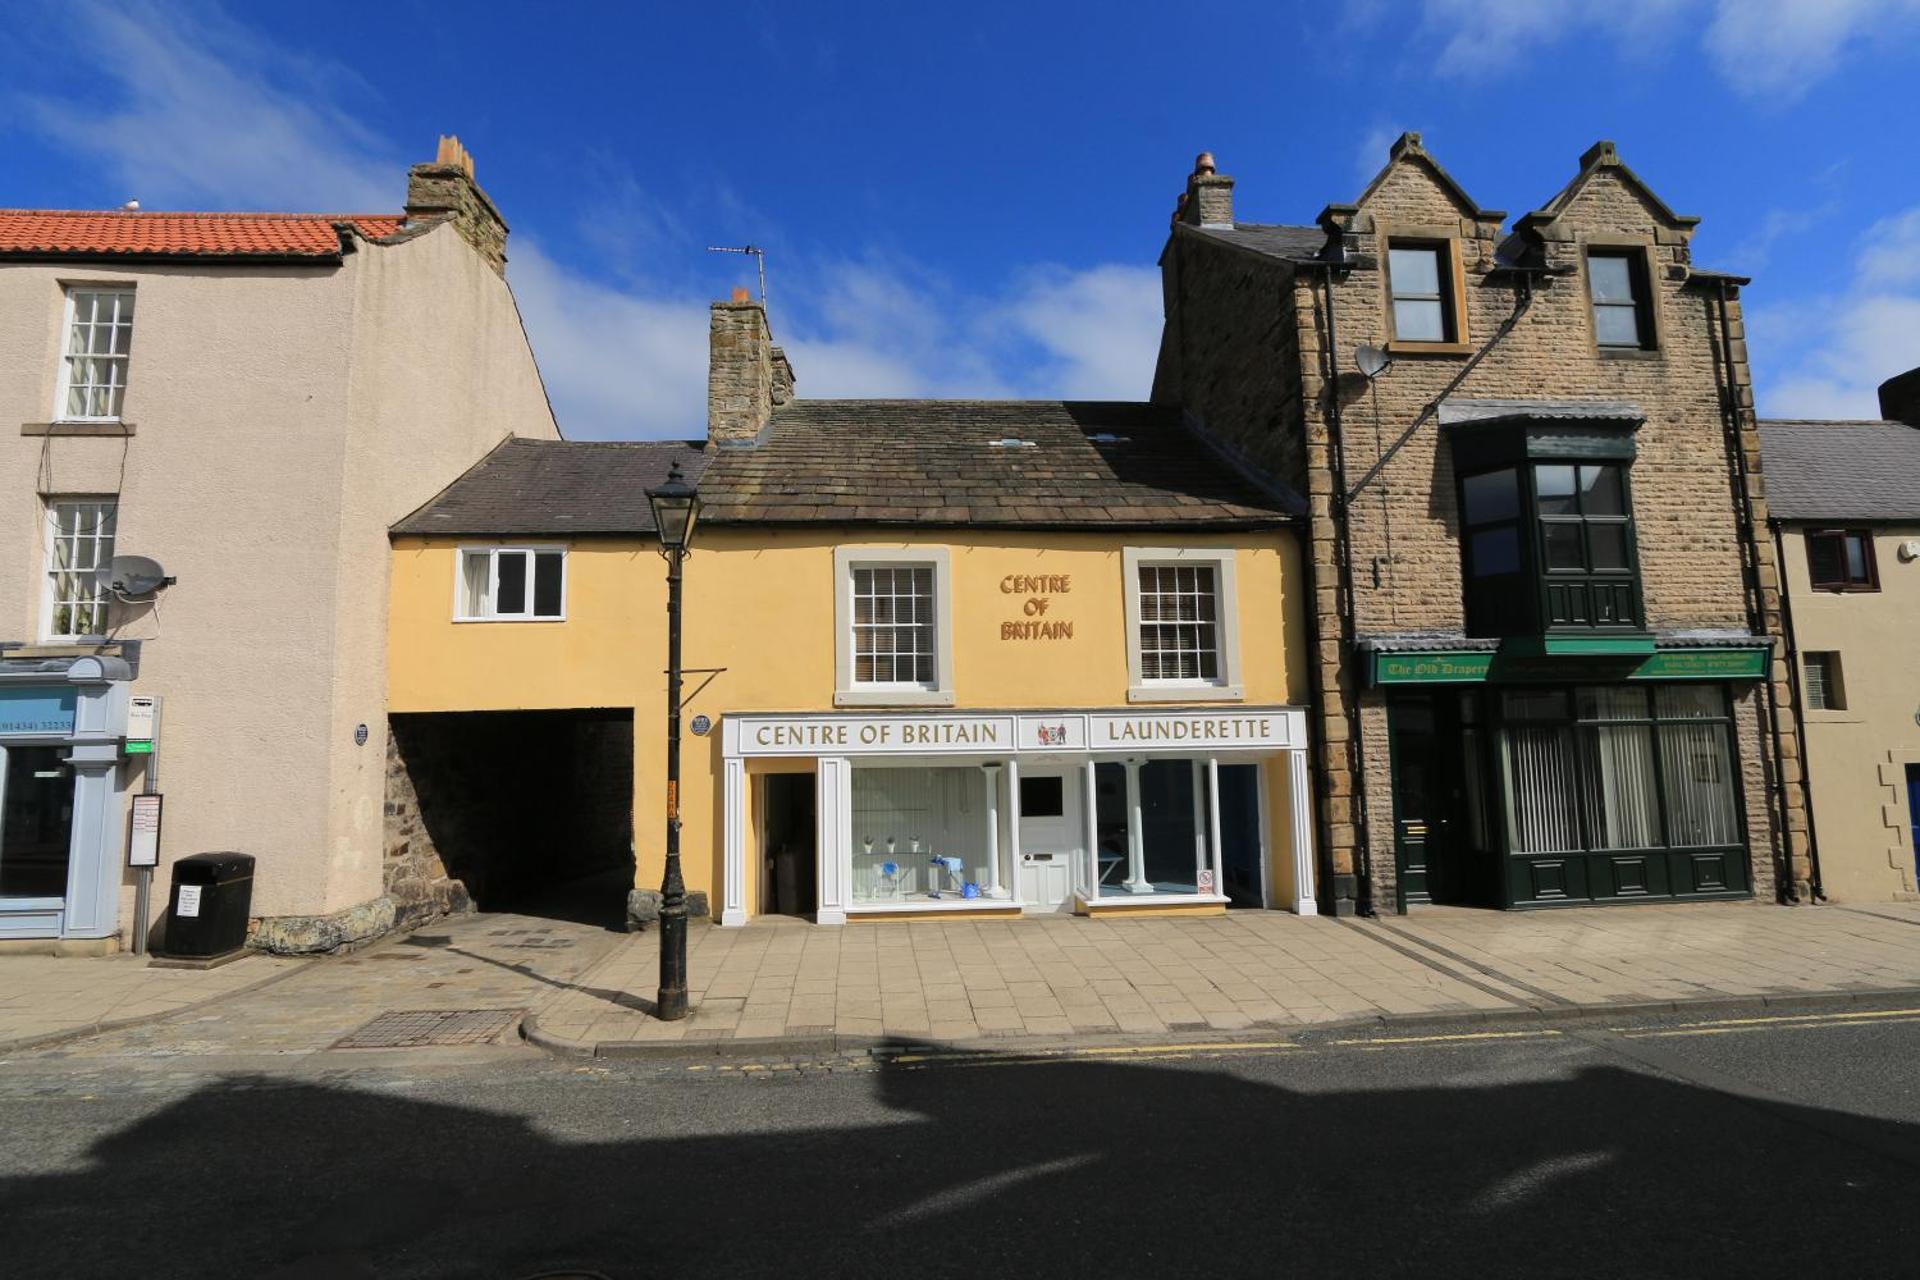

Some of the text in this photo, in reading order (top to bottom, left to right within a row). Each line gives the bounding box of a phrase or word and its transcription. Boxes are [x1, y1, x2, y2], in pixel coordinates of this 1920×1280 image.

[1000, 574, 1071, 594] CENTRE
[1023, 597, 1049, 616] OF
[1000, 620, 1073, 640] BRITAIN
[1388, 663, 1409, 675] The
[1415, 663, 1438, 674] Old
[756, 724, 998, 745] CENTRE OF BRITAIN
[1109, 719, 1270, 740] LAUNDERETTE
